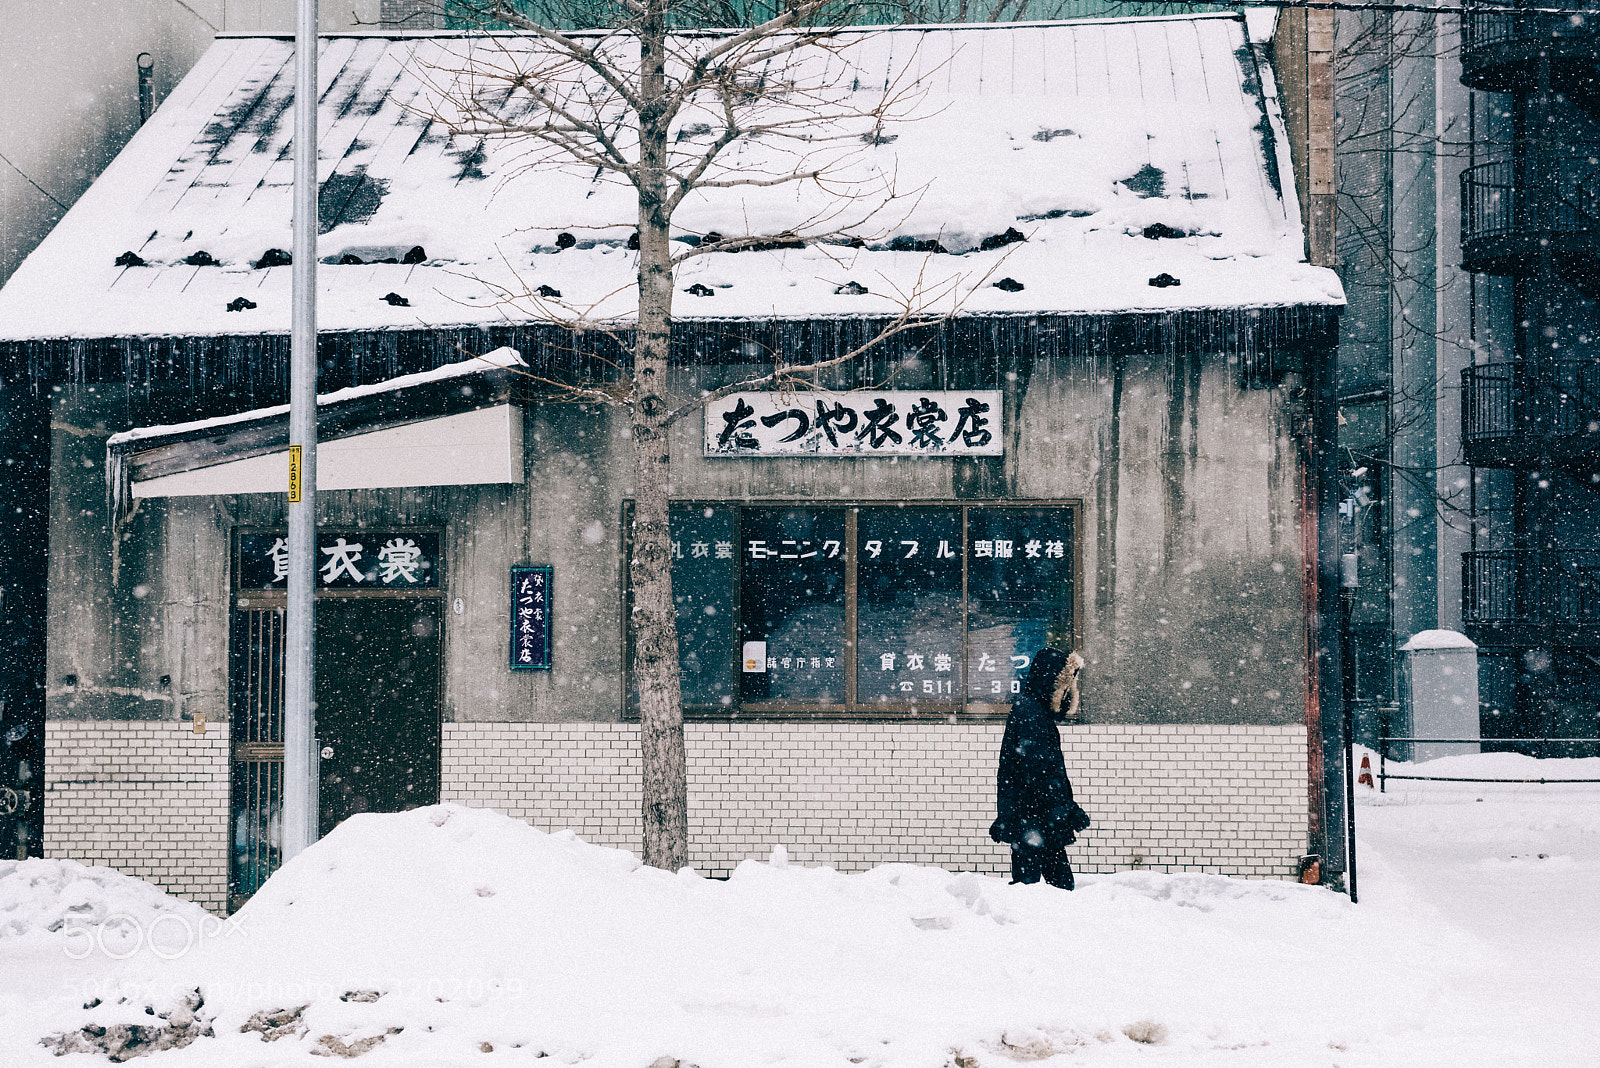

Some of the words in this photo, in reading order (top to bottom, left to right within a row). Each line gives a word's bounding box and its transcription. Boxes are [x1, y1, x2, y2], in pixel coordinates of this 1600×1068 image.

[715, 398, 993, 449] たつや衣裳店
[519, 578, 535, 662] たつや衣裳店
